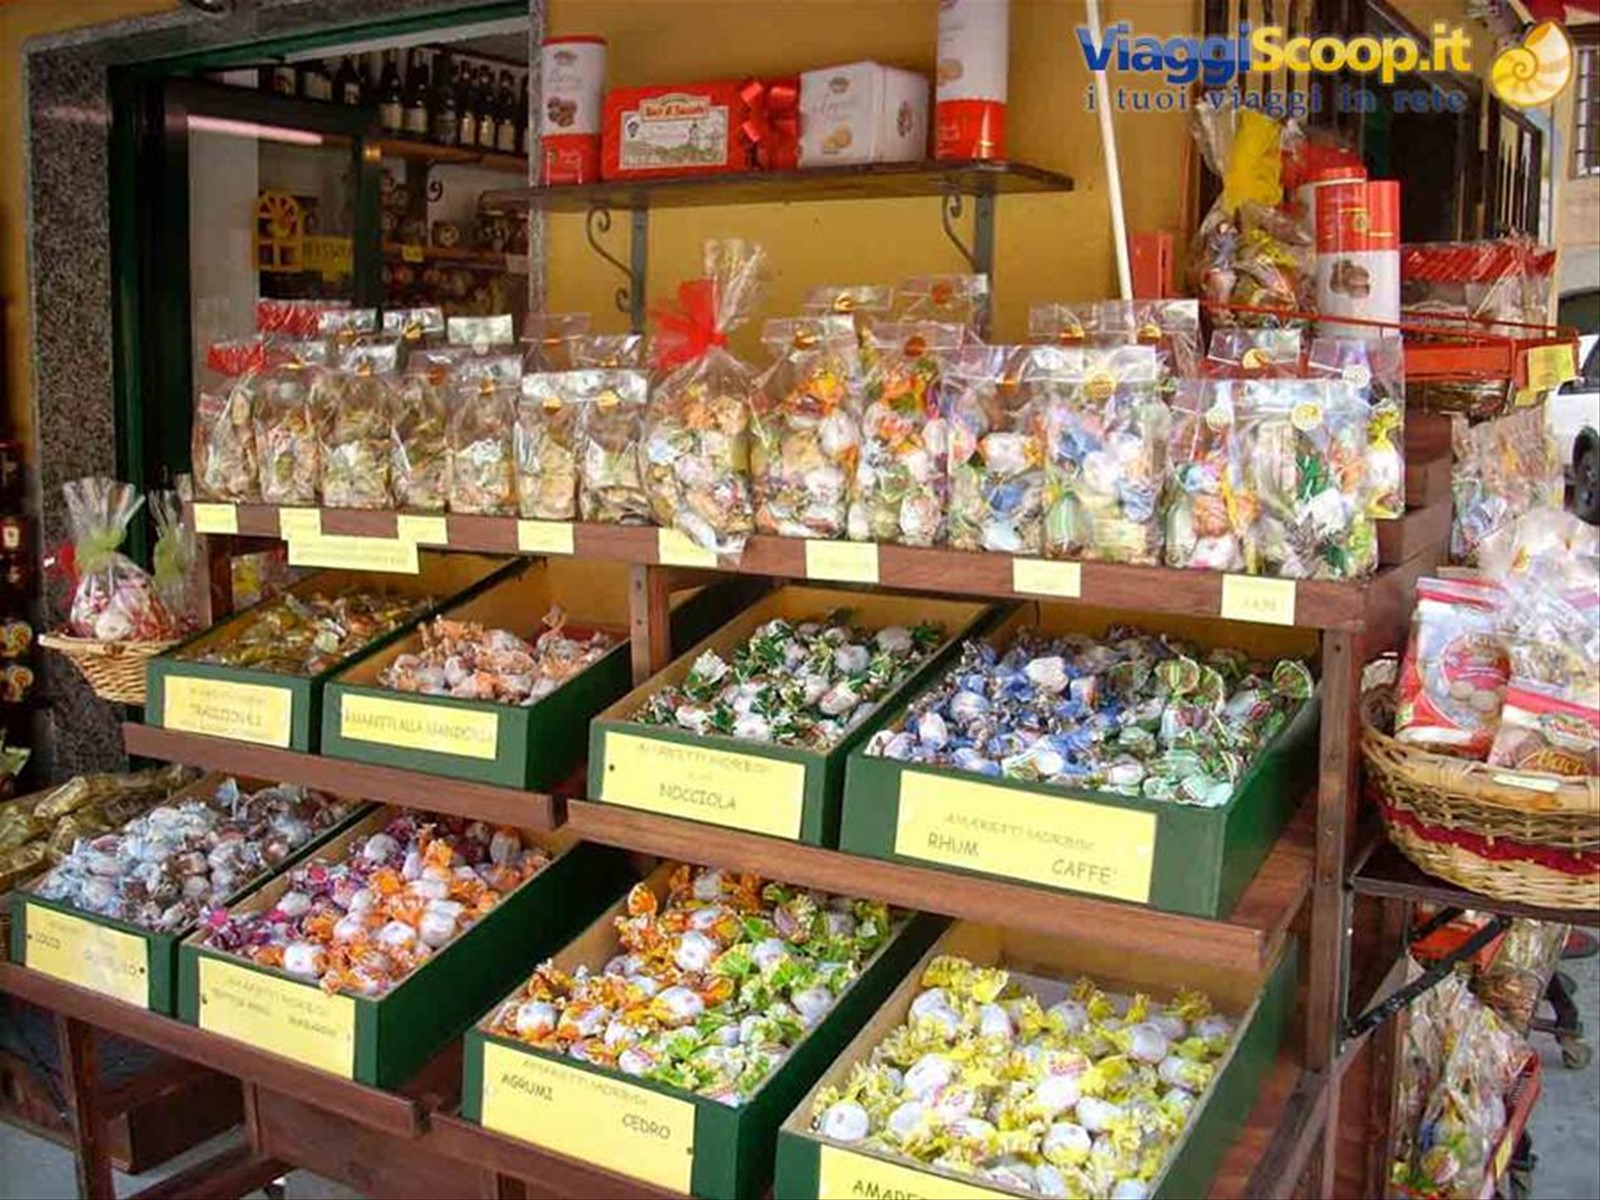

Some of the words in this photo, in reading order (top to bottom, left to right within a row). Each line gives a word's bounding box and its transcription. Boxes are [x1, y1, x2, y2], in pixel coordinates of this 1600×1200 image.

[659, 782, 737, 811] NOCCIOLA
[927, 831, 979, 857] RHUM
[501, 1073, 553, 1102] AGRUMI
[622, 1113, 672, 1140] CEDRO
